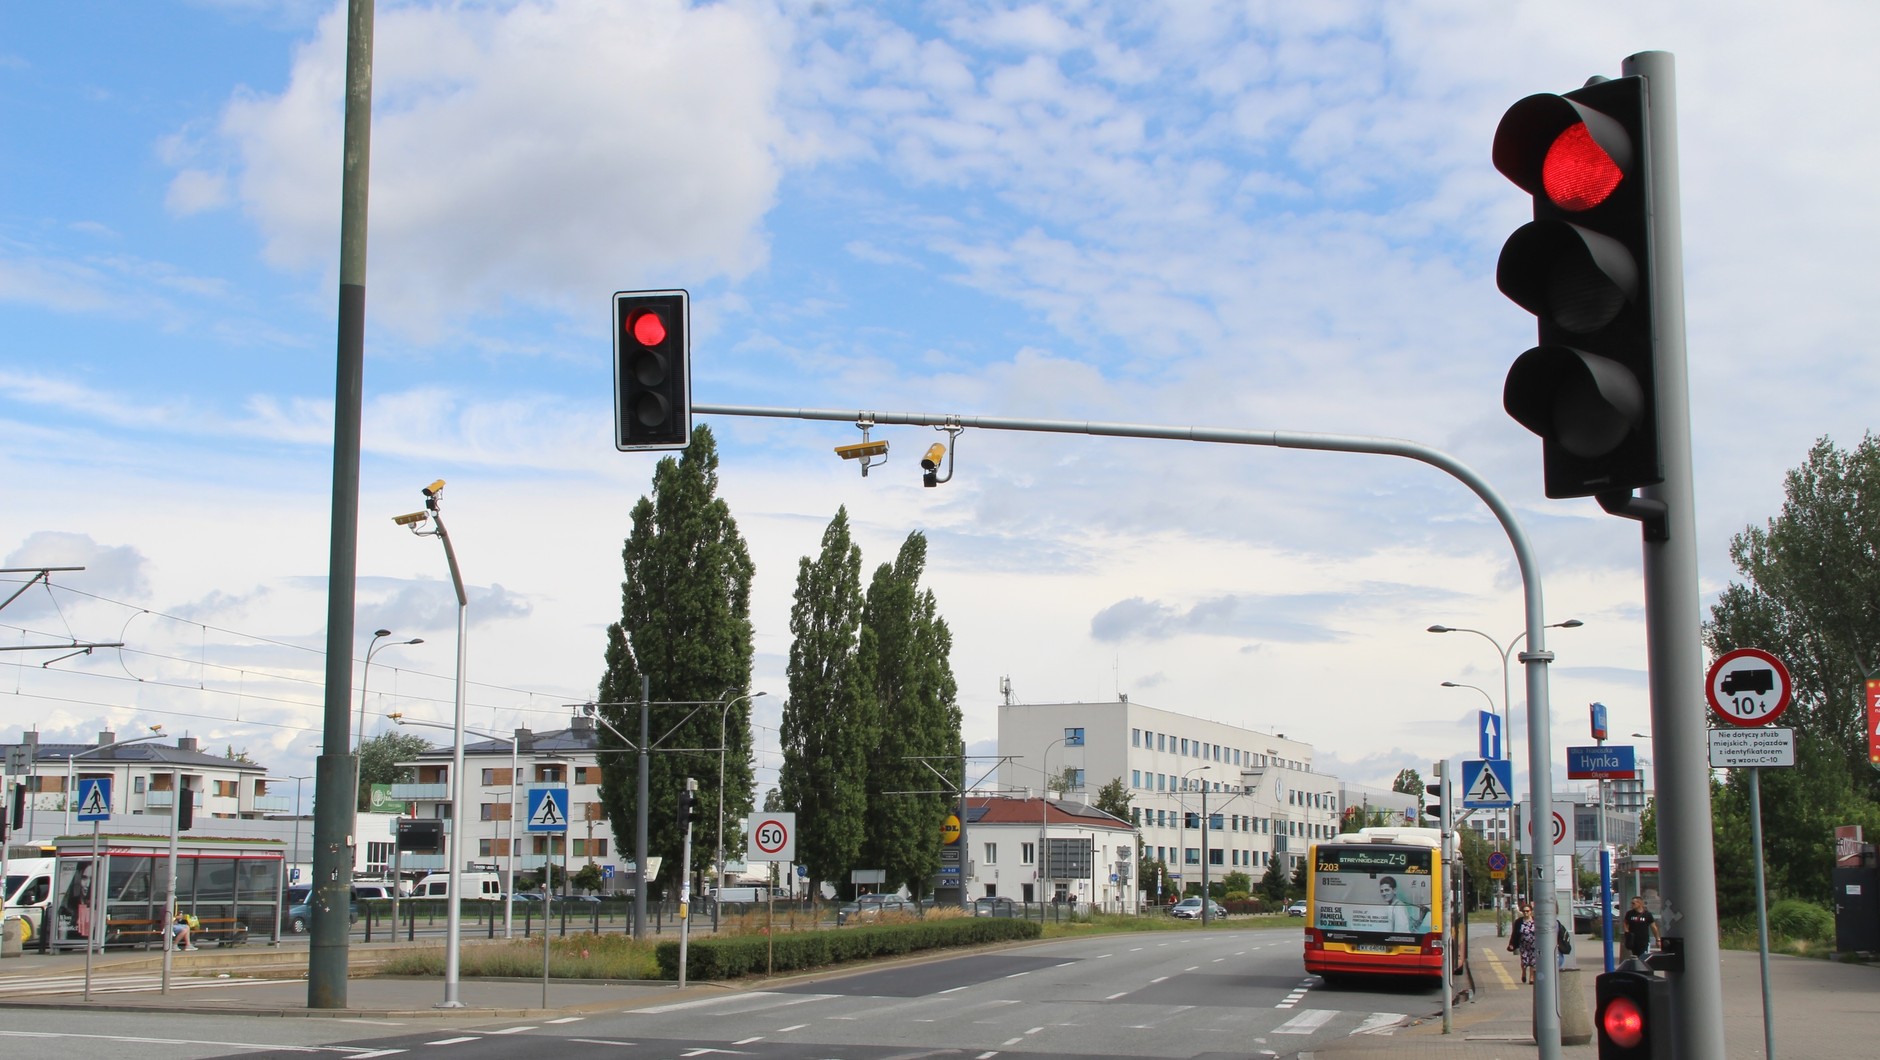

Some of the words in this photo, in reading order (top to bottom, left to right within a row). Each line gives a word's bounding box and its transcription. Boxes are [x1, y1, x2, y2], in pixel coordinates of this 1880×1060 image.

[1732, 697, 1755, 715] 10
[1759, 700, 1767, 713] t
[1732, 731, 1759, 740] dotyczy
[1753, 740, 1788, 749] pojazdów
[1724, 748, 1783, 756] identyfikatorem
[1581, 754, 1619, 771] Hynka
[761, 829, 782, 844] 50
[1388, 853, 1407, 865] Z-9
[1318, 862, 1339, 872] 7203
[1322, 877, 1330, 886] 81
